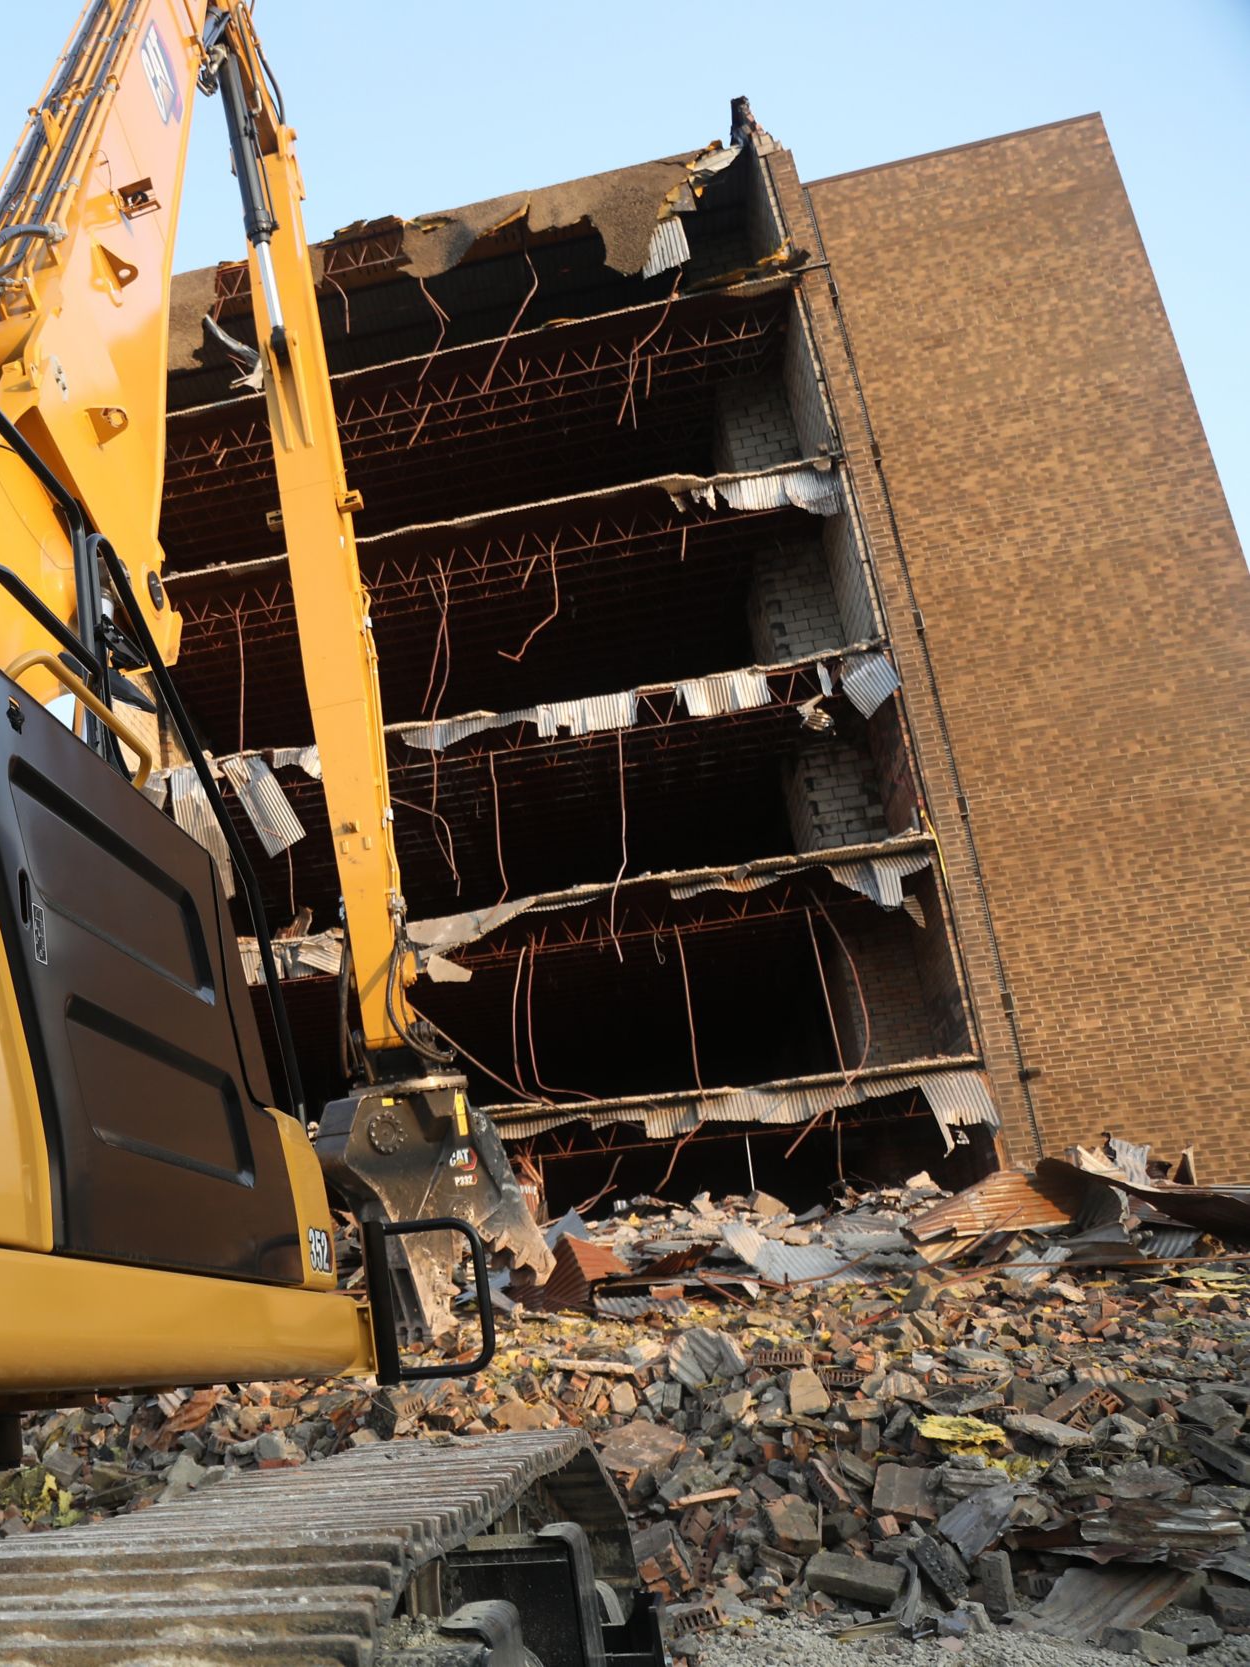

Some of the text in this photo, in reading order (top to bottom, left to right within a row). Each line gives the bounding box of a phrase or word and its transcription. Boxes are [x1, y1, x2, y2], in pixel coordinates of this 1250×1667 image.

[449, 1149, 470, 1167] CAT
[454, 1175, 473, 1187] P332
[308, 1227, 330, 1271] 352
